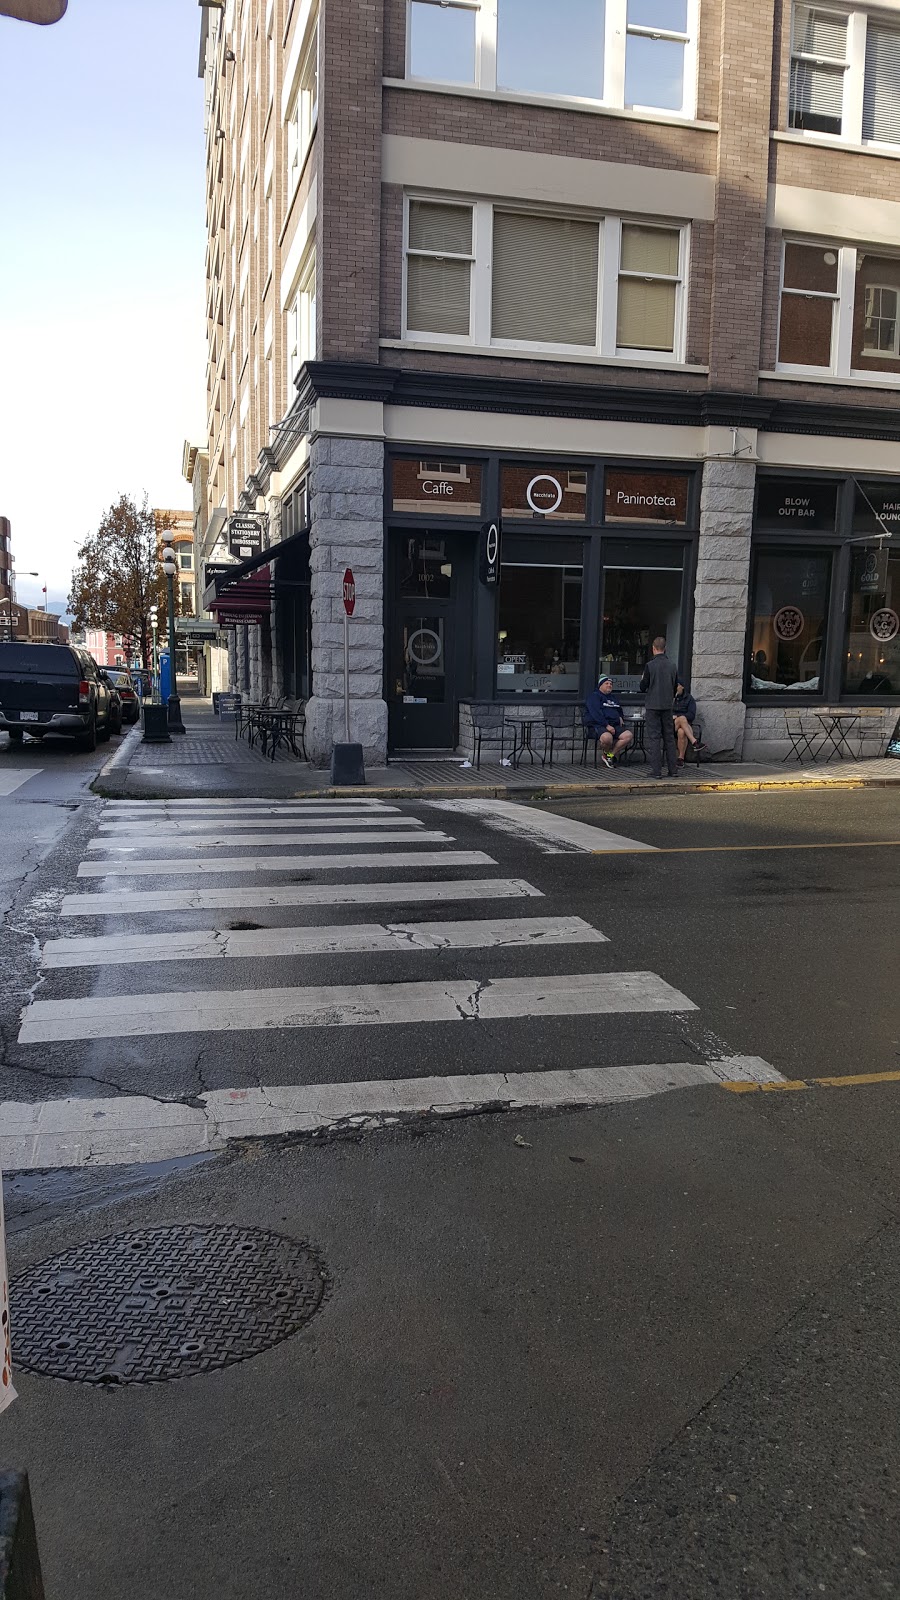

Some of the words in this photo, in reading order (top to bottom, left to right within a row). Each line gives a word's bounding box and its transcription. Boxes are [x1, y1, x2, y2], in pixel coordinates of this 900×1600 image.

[422, 481, 454, 495] Caffe
[616, 491, 677, 507] Paninoteca
[785, 497, 810, 506] BLOW
[778, 508, 795, 516] OUT
[798, 509, 815, 517] BAR
[418, 573, 435, 583] 1002
[343, 582, 355, 601] STOP
